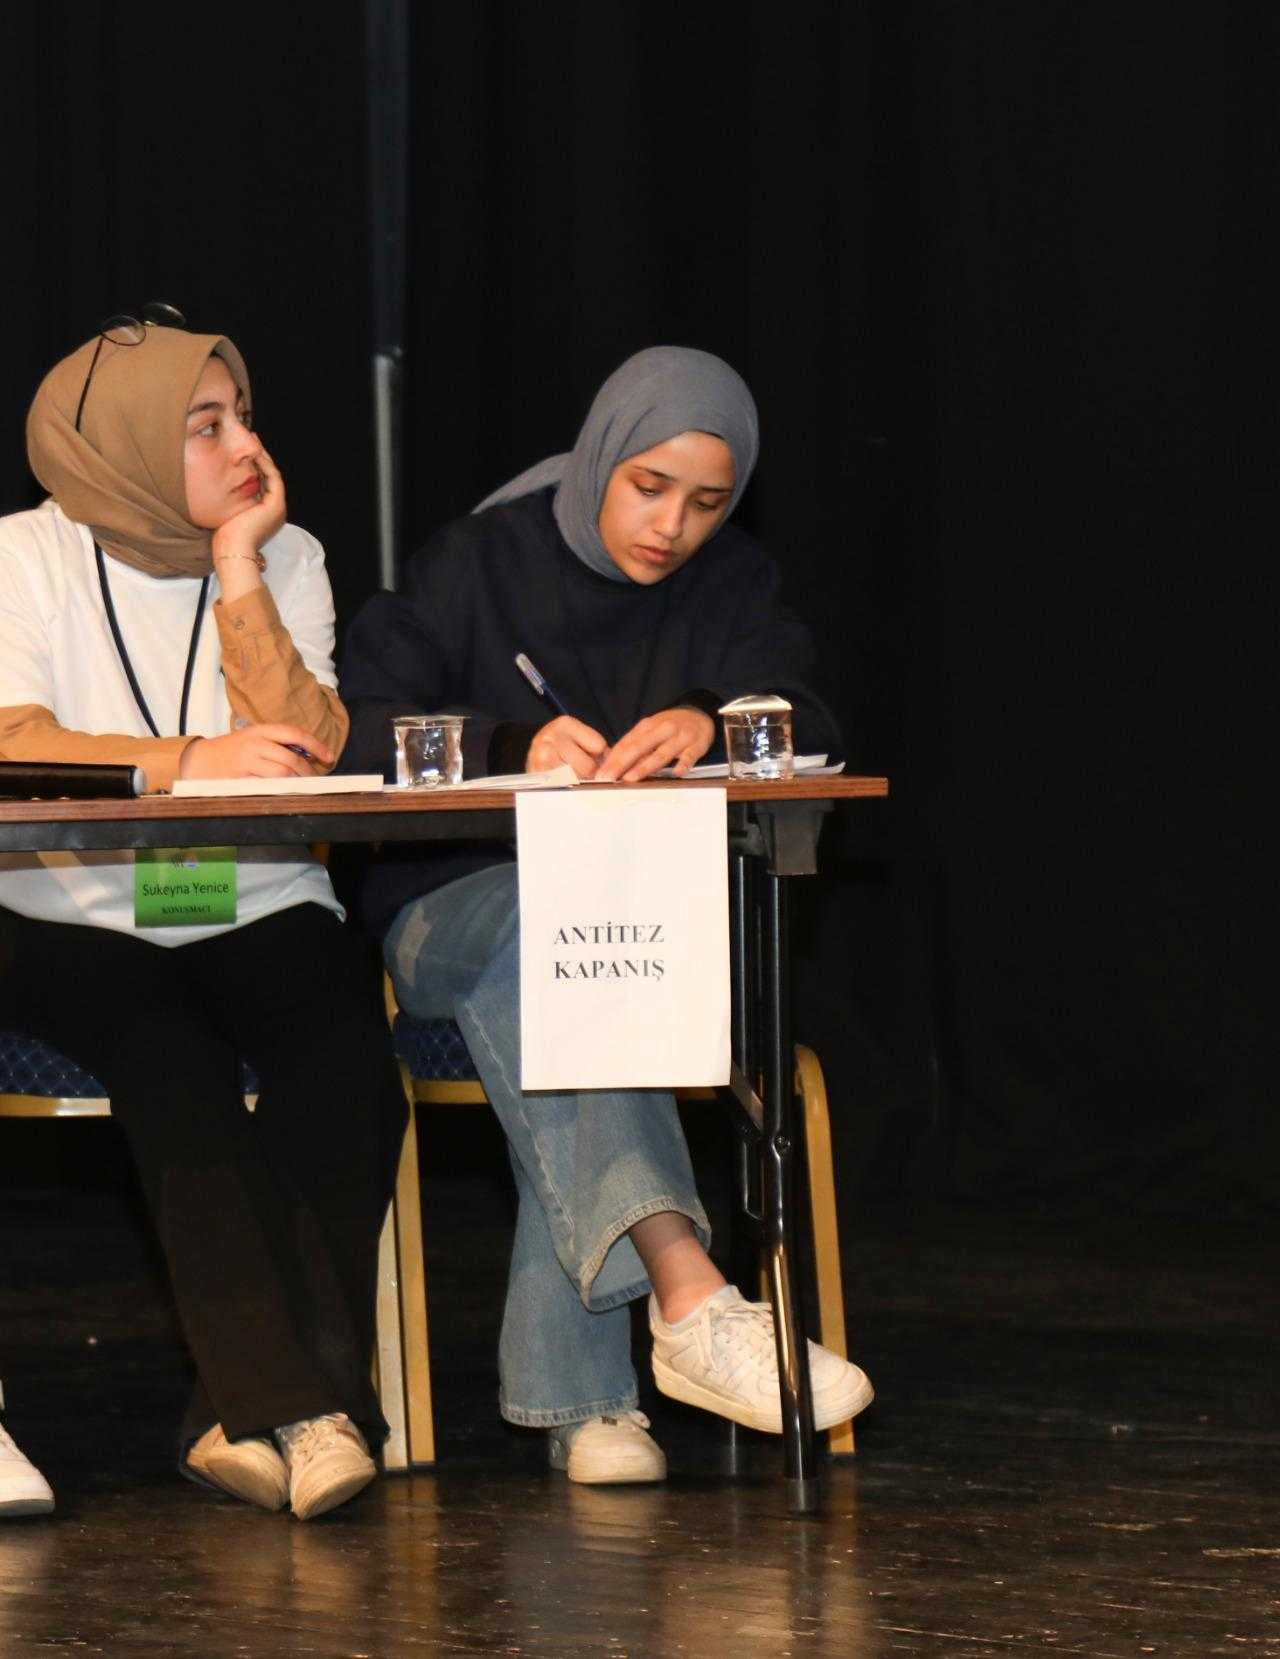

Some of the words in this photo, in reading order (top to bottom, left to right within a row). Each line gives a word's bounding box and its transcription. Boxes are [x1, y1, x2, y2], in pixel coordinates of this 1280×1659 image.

[192, 882, 228, 894] Yenice
[553, 921, 665, 945] ANTİTEZ
[554, 959, 665, 981] KAPANIŞ
